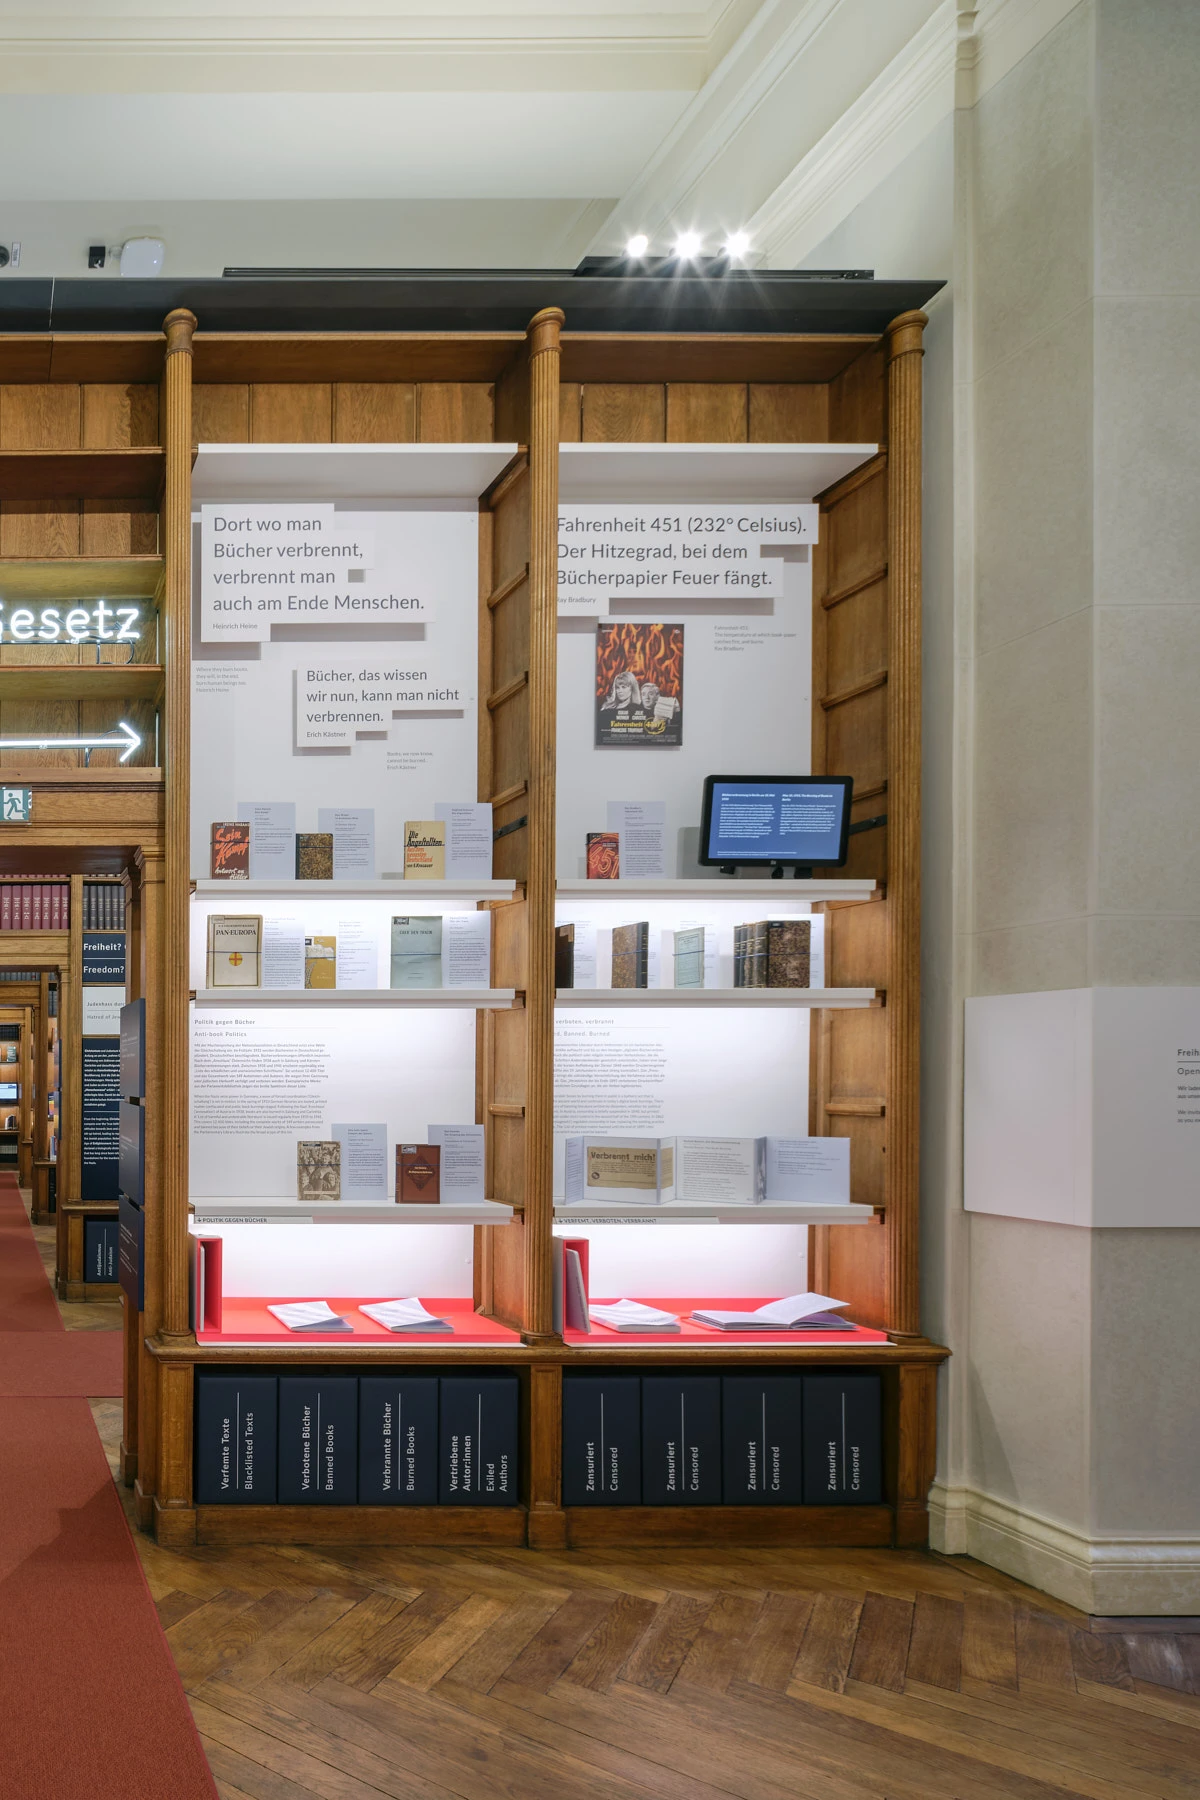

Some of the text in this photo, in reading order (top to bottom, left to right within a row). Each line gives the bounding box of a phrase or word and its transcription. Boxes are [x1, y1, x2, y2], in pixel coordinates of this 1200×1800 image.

[214, 517, 321, 531] Dort wo man
[557, 517, 646, 532] Fahrenheit
[650, 518, 682, 532] 451
[737, 517, 806, 534] Celsius).
[214, 542, 362, 559] Bücher verbrennt,
[557, 544, 747, 561] Der Hitzegrad, bei dem
[213, 569, 335, 584] verbrennt man
[557, 570, 772, 588] Bücherpapier Feuer fängt.
[213, 594, 424, 611] auch am Ende Menschen.
[557, 595, 596, 605] ay Bradbury
[212, 622, 258, 630] Heinrich Heine
[307, 669, 427, 683] Bücher, das wissen
[307, 689, 459, 703] wir nun, kann man nicht
[307, 711, 383, 722] verbrennen.
[306, 730, 346, 738] Erich Kästner
[83, 942, 121, 951] Freiheit?
[83, 965, 124, 974] Freedom?
[591, 1151, 656, 1161] Verbrennt mich!
[220, 1419, 230, 1490] Verfemte Texte
[244, 1413, 254, 1490] Blacklisted Texts
[301, 1406, 311, 1491] Verbotene Bücher
[325, 1425, 334, 1491] Banned Books
[382, 1403, 392, 1491] Verbrannte Bücher
[406, 1426, 416, 1491] Burned Books
[449, 1436, 459, 1492] Vertriebene
[462, 1436, 472, 1492] Autor:innen
[485, 1464, 495, 1492] Exiled
[498, 1455, 508, 1492] Authors
[585, 1443, 595, 1491] Zensuriert
[609, 1448, 619, 1492] Censored
[666, 1442, 676, 1491] Zensuriert
[689, 1447, 699, 1491] Censored
[747, 1442, 757, 1491] Zensuriert
[770, 1447, 780, 1491] Censored
[827, 1442, 837, 1491] Zensuriert
[850, 1447, 860, 1491] Censored
